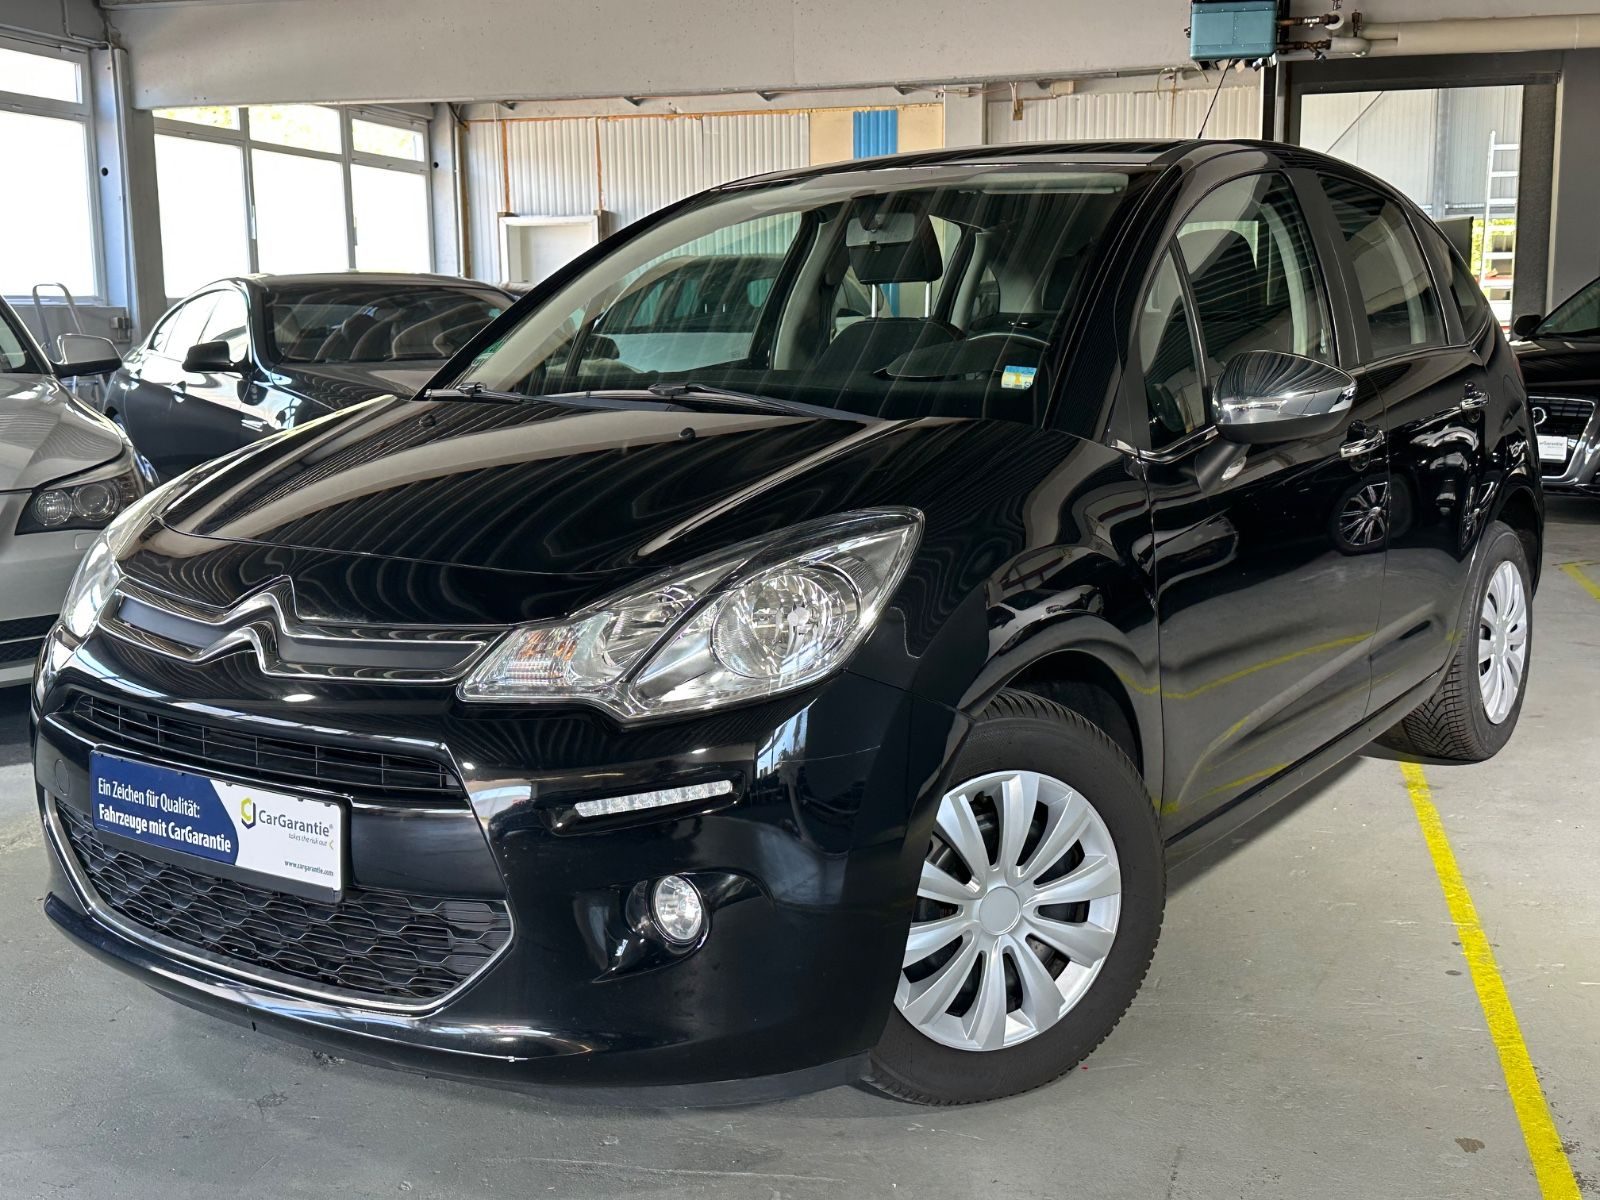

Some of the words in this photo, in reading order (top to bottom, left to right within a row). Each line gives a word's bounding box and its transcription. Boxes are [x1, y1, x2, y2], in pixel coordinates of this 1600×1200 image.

[98, 777, 111, 796] Ein
[112, 781, 144, 805] Zeichen
[146, 789, 159, 809] für
[160, 793, 200, 818] Qualität:
[98, 803, 148, 835] Fahrzeuge
[149, 819, 167, 838] mit
[168, 821, 232, 853] CarGarantie
[284, 860, 334, 877] www.cargarantie.com
